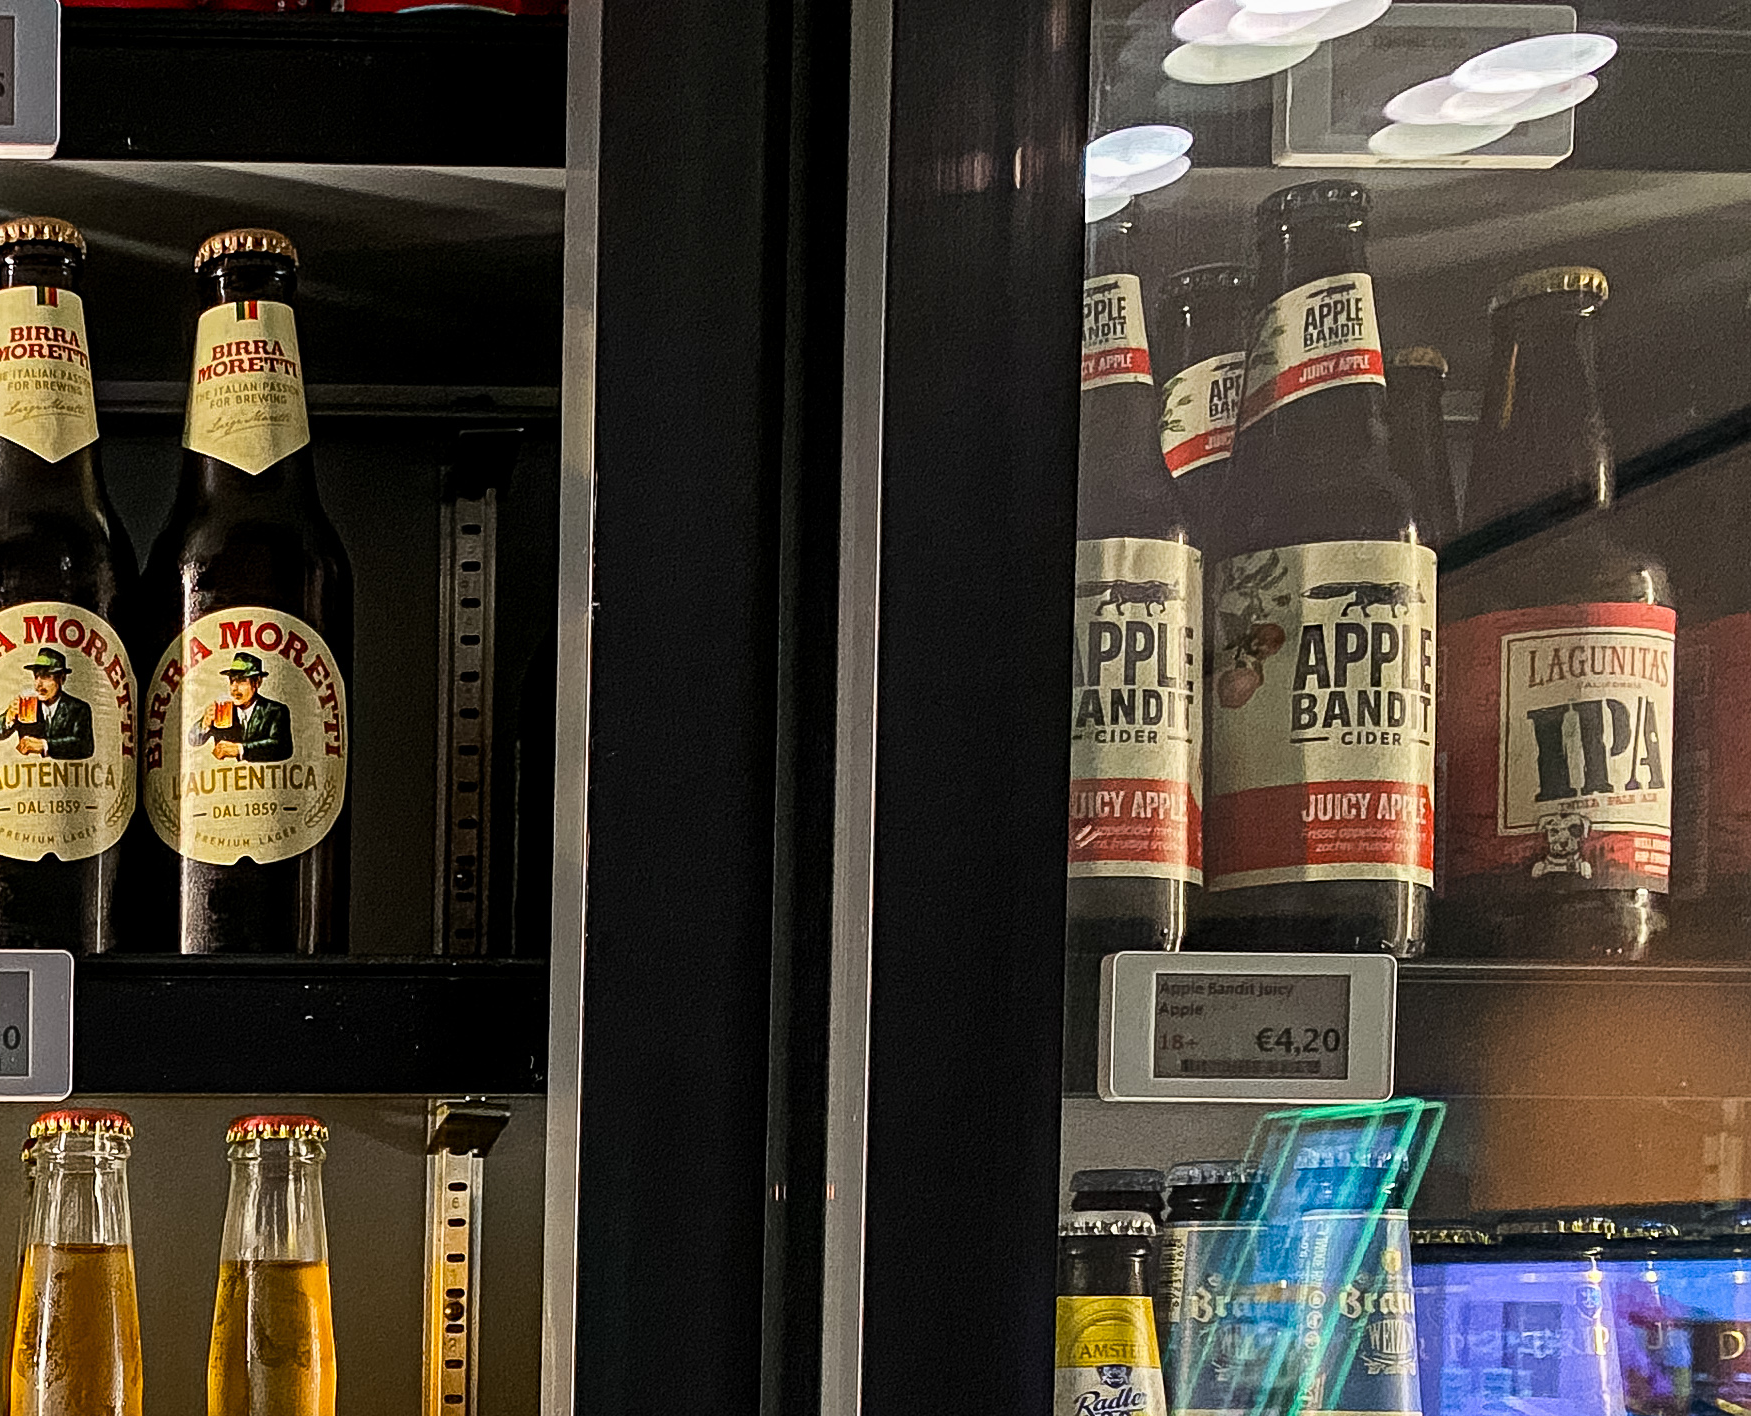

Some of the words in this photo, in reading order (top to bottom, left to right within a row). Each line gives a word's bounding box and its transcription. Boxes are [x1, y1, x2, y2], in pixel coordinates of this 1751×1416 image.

[1305, 297, 1363, 334] APPLE
[9, 326, 80, 348] BIRRA
[1303, 322, 1363, 349] BANDIT
[211, 339, 285, 362] BIRRA
[13, 368, 56, 380] ITALIAN
[197, 356, 298, 384] MORETTI
[1300, 363, 1335, 383] JUICY
[214, 382, 258, 397] ITALIAN
[1293, 623, 1433, 694] APPLE
[1528, 645, 1669, 689] LAGUNITAS
[24, 616, 135, 759] MORETTI
[219, 621, 343, 759] MORETTI
[1076, 688, 1194, 731] ANDIT
[1290, 690, 1433, 734] BANDIT
[1095, 730, 1158, 744] CIDER
[1341, 731, 1402, 746] CIDER
[1527, 696, 1665, 802] IPA
[173, 767, 318, 799] L'AUTENTICA
[18, 800, 46, 815] DAL
[49, 800, 80, 815] 1859
[213, 804, 241, 819] DAL
[245, 802, 277, 817] 1859
[1131, 790, 1189, 822] APPLE
[1302, 792, 1371, 823] JUICY
[1377, 792, 1427, 825] APPLE
[1159, 982, 1204, 998] Apple
[1208, 982, 1254, 996] Bandit
[1158, 1003, 1203, 1018] Apple
[1159, 1033, 1198, 1050] 18+
[1255, 1027, 1340, 1056] €4,20
[1340, 1286, 1414, 1319] Bran
[1079, 1341, 1139, 1361] AMSTE
